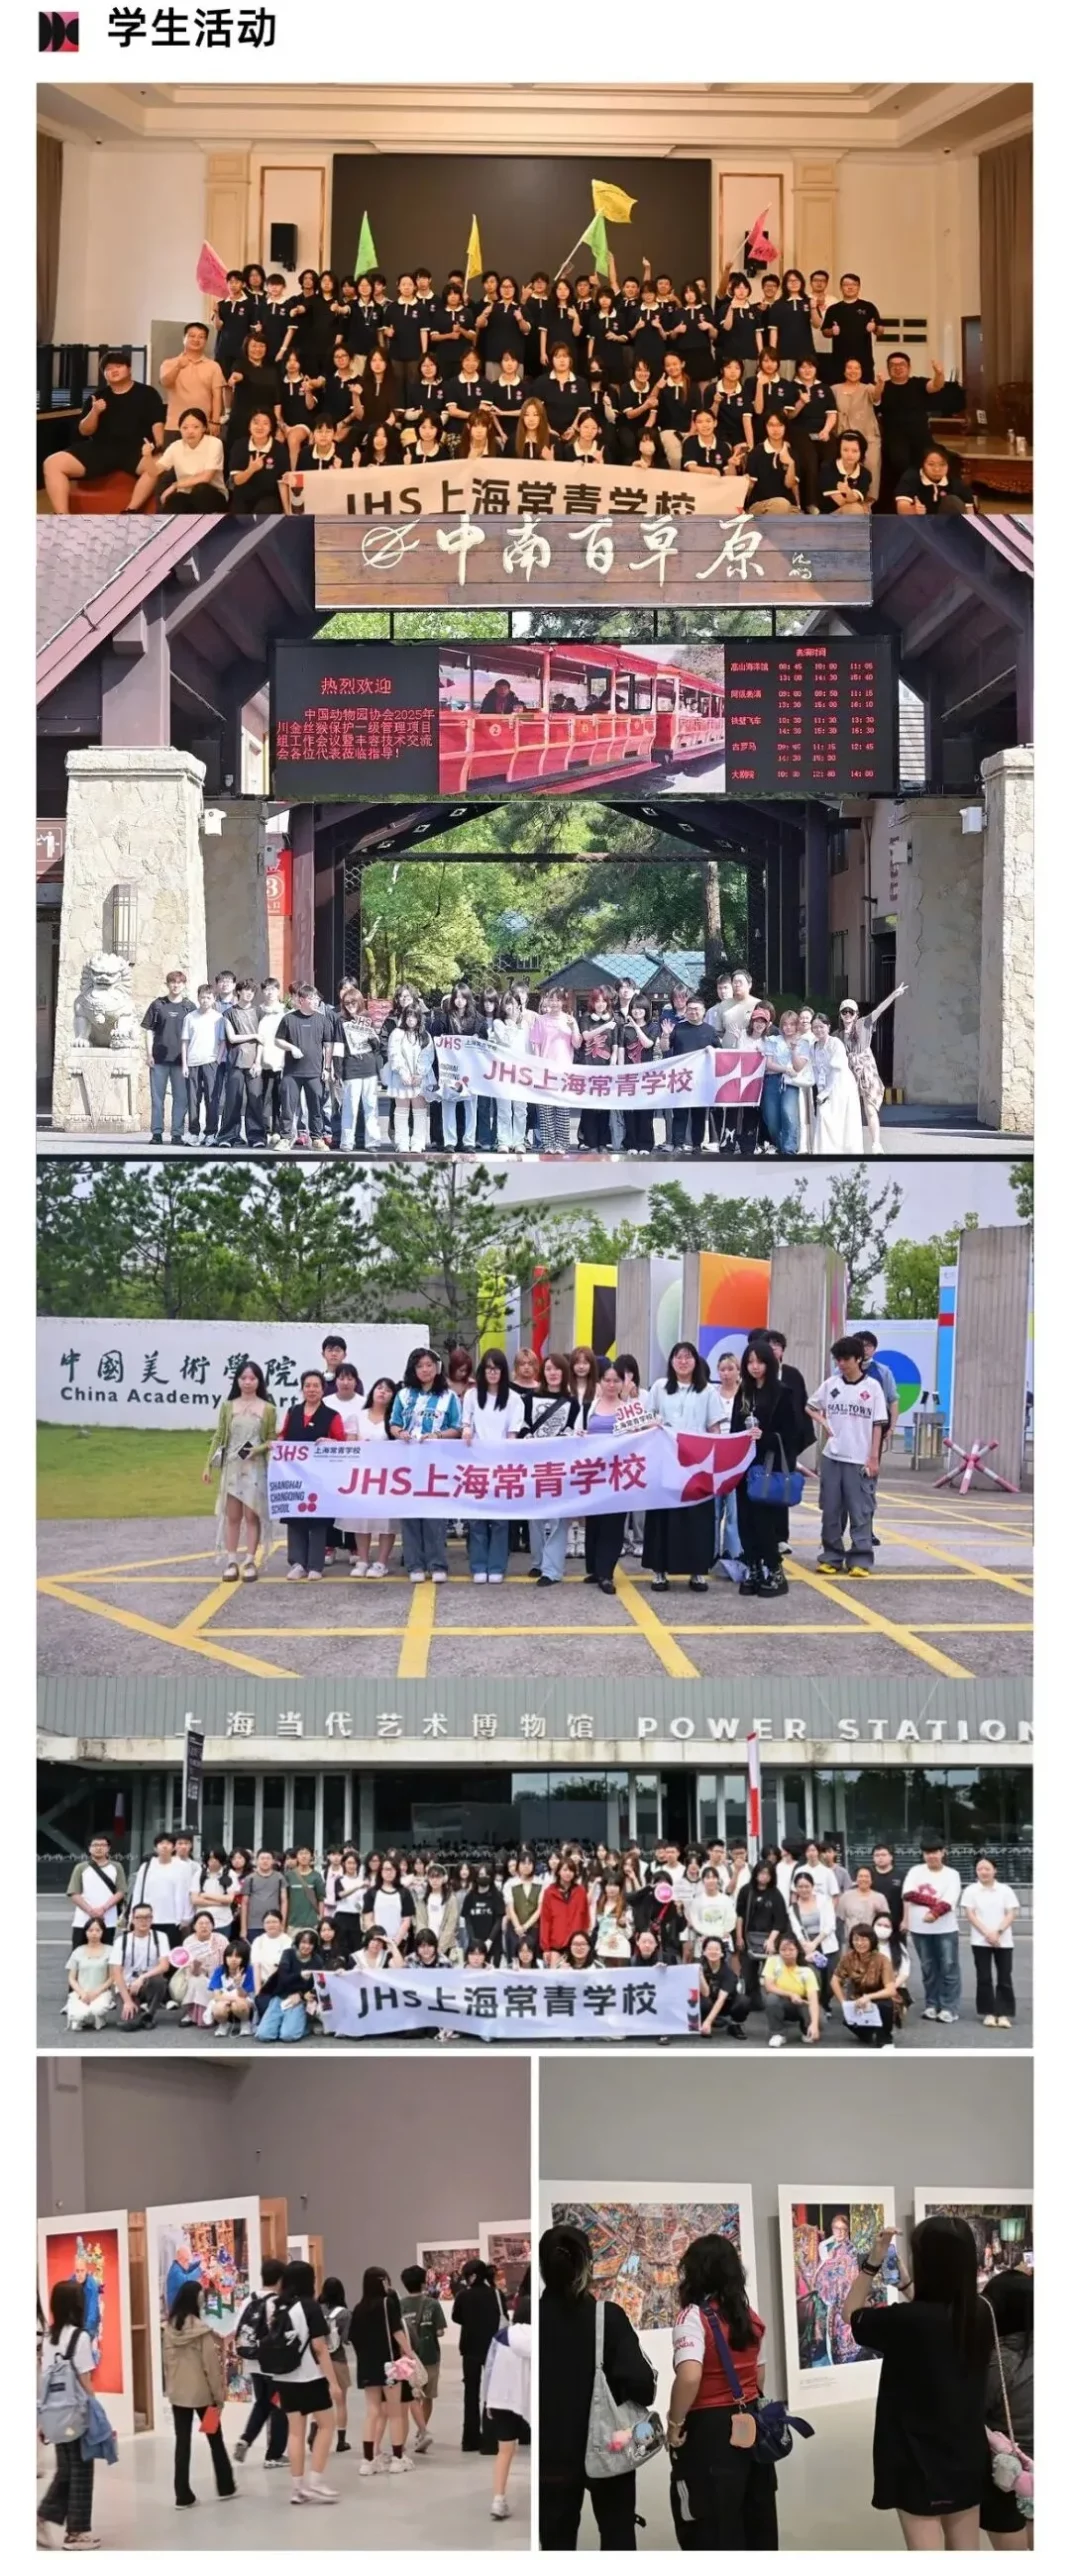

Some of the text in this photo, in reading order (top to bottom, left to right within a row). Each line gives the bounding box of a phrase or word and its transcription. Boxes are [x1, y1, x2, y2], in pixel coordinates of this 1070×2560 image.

[436, 513, 764, 588] 中南百草原
[321, 677, 392, 695] 热烈欢迎
[304, 708, 435, 721] 中国动物园协会2025年
[276, 722, 431, 734] 川金丝猴保护一级管理项目
[276, 735, 433, 747] 组工作会议暨丰容技术交流
[436, 1037, 462, 1050] JHS
[483, 1060, 694, 1098] JHS上海常青学校
[60, 1386, 222, 1408] China Academy
[272, 1445, 309, 1462] JHS
[338, 1453, 648, 1500] JHS上海常青学校
[175, 1711, 594, 1739] 上海当代艺术博物馆
[637, 1716, 1034, 1741] POWER STATION
[358, 1982, 658, 2019] JHS上海常青学校
